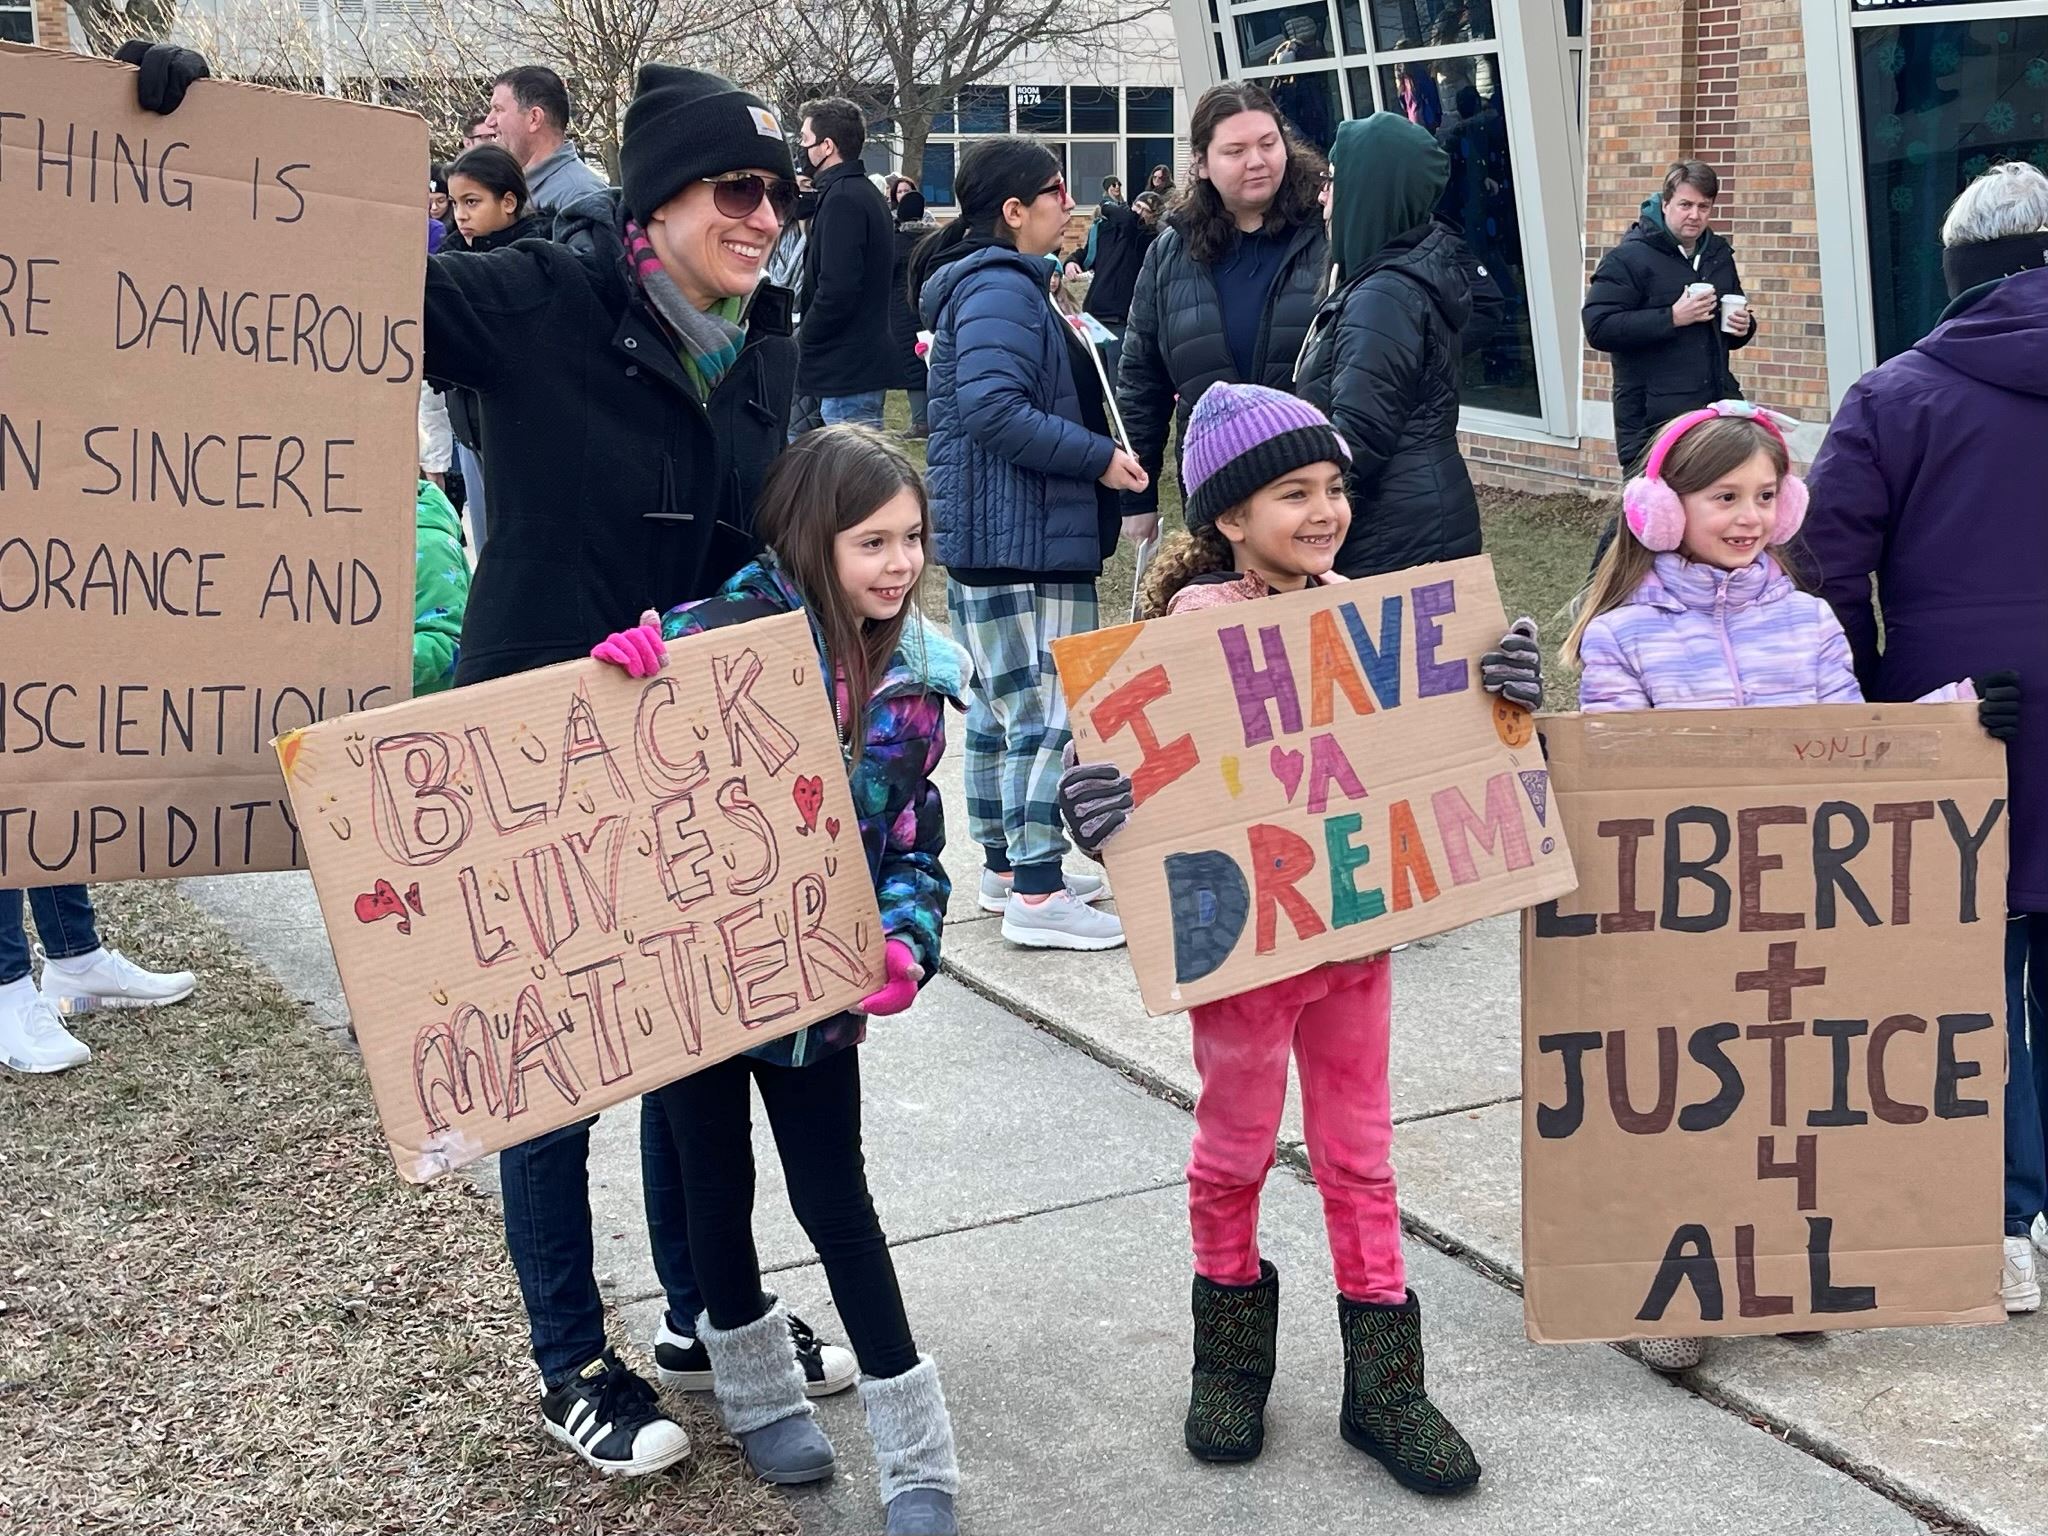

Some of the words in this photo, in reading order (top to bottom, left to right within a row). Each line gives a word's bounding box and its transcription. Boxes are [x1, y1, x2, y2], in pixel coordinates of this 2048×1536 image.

[1017, 86, 1040, 94] ROOM
[1017, 94, 1042, 105] #174
[250, 156, 311, 223] IS
[114, 270, 419, 384] DANGEROUS
[82, 426, 364, 518] SINCERE
[0, 537, 227, 618] ORANCE
[259, 554, 382, 626] AND
[1089, 663, 1201, 809] I
[1217, 579, 1469, 748] HAVE
[370, 647, 800, 866] BLACK
[1307, 733, 1369, 814] A
[1163, 769, 1556, 984] DREAM!
[413, 871, 874, 1139] MATTER
[1536, 1012, 1995, 1139] JUSTICE
[1756, 1134, 1818, 1211] 4
[1634, 1216, 1877, 1322] ALL
